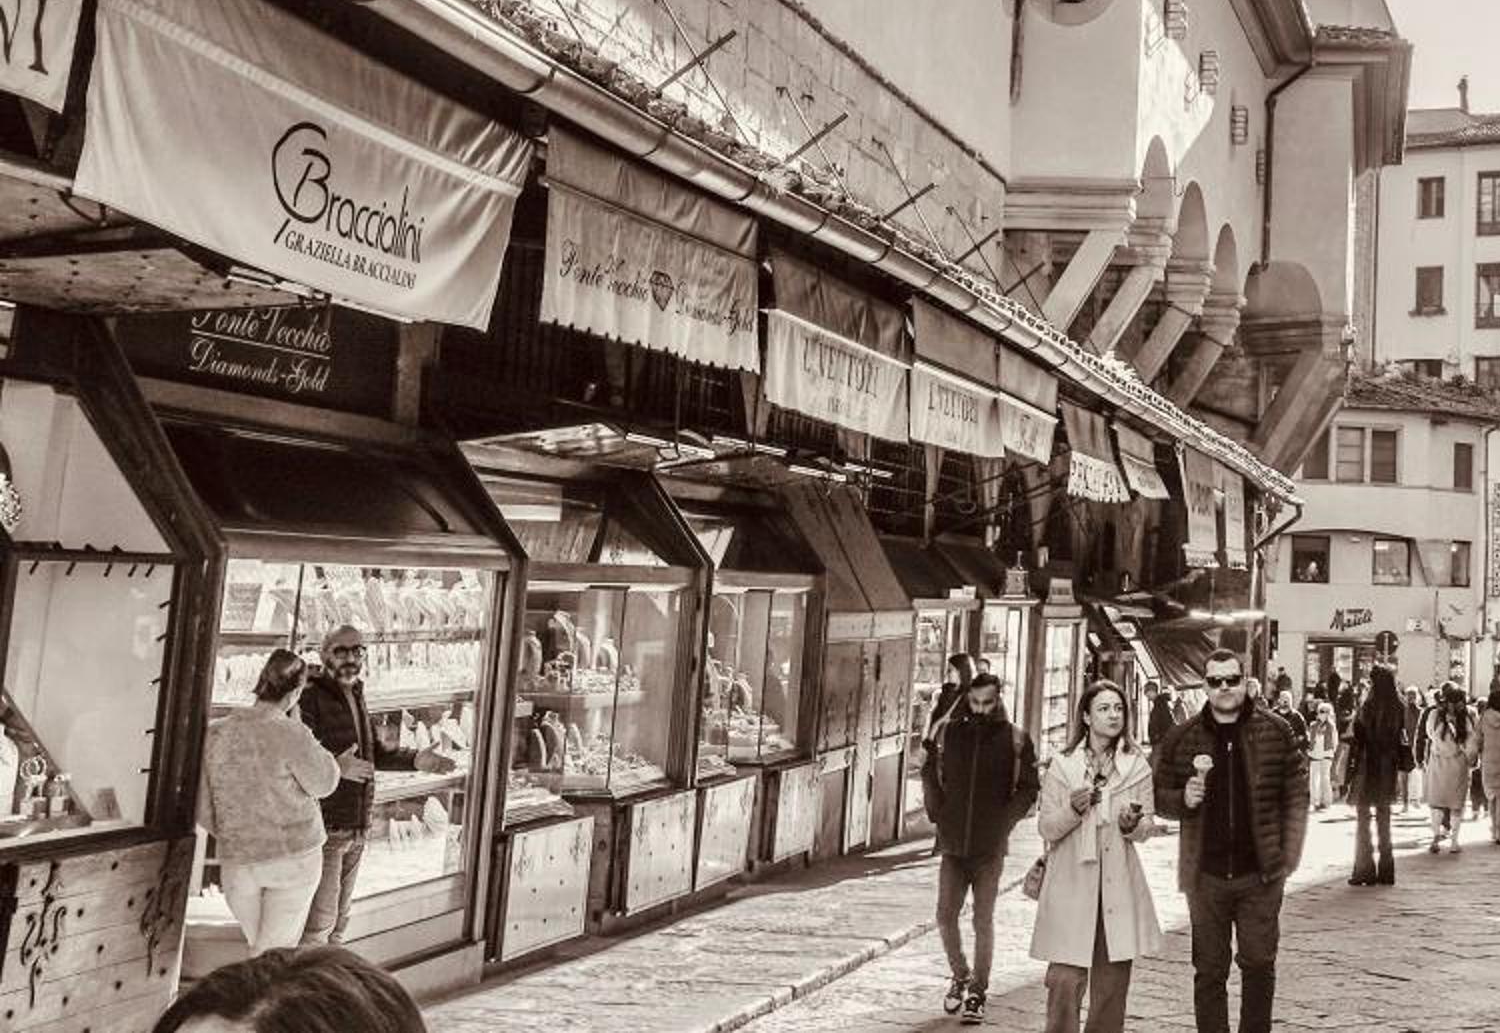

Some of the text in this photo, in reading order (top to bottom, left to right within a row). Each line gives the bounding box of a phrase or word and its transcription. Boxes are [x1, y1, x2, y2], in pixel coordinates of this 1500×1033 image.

[271, 121, 425, 265] Braccialini
[284, 229, 417, 290] GRAZIELLA BRACCIALINI
